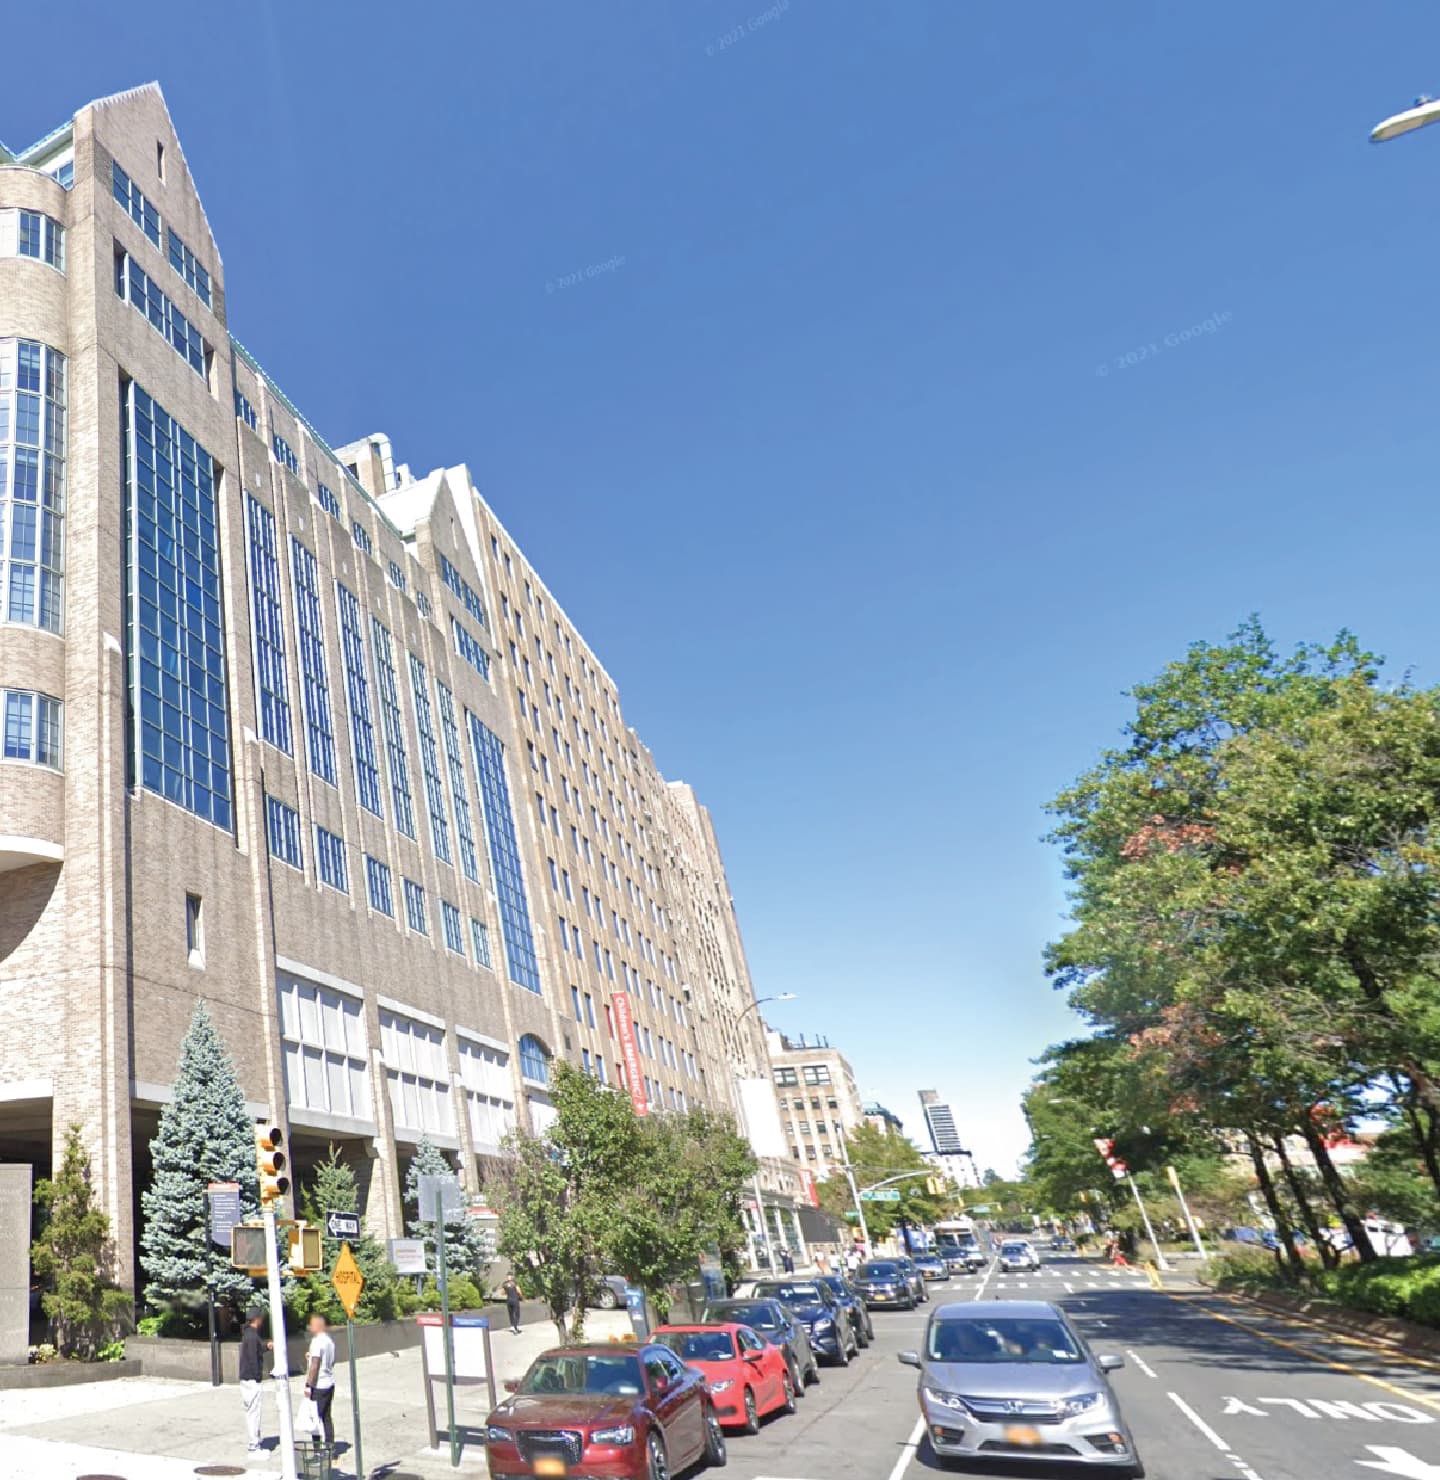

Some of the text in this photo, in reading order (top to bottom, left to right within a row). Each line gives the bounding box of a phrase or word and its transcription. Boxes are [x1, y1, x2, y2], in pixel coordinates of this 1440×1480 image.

[330, 1219, 356, 1232] ONE WAY
[1220, 1396, 1436, 1424] ONLY
